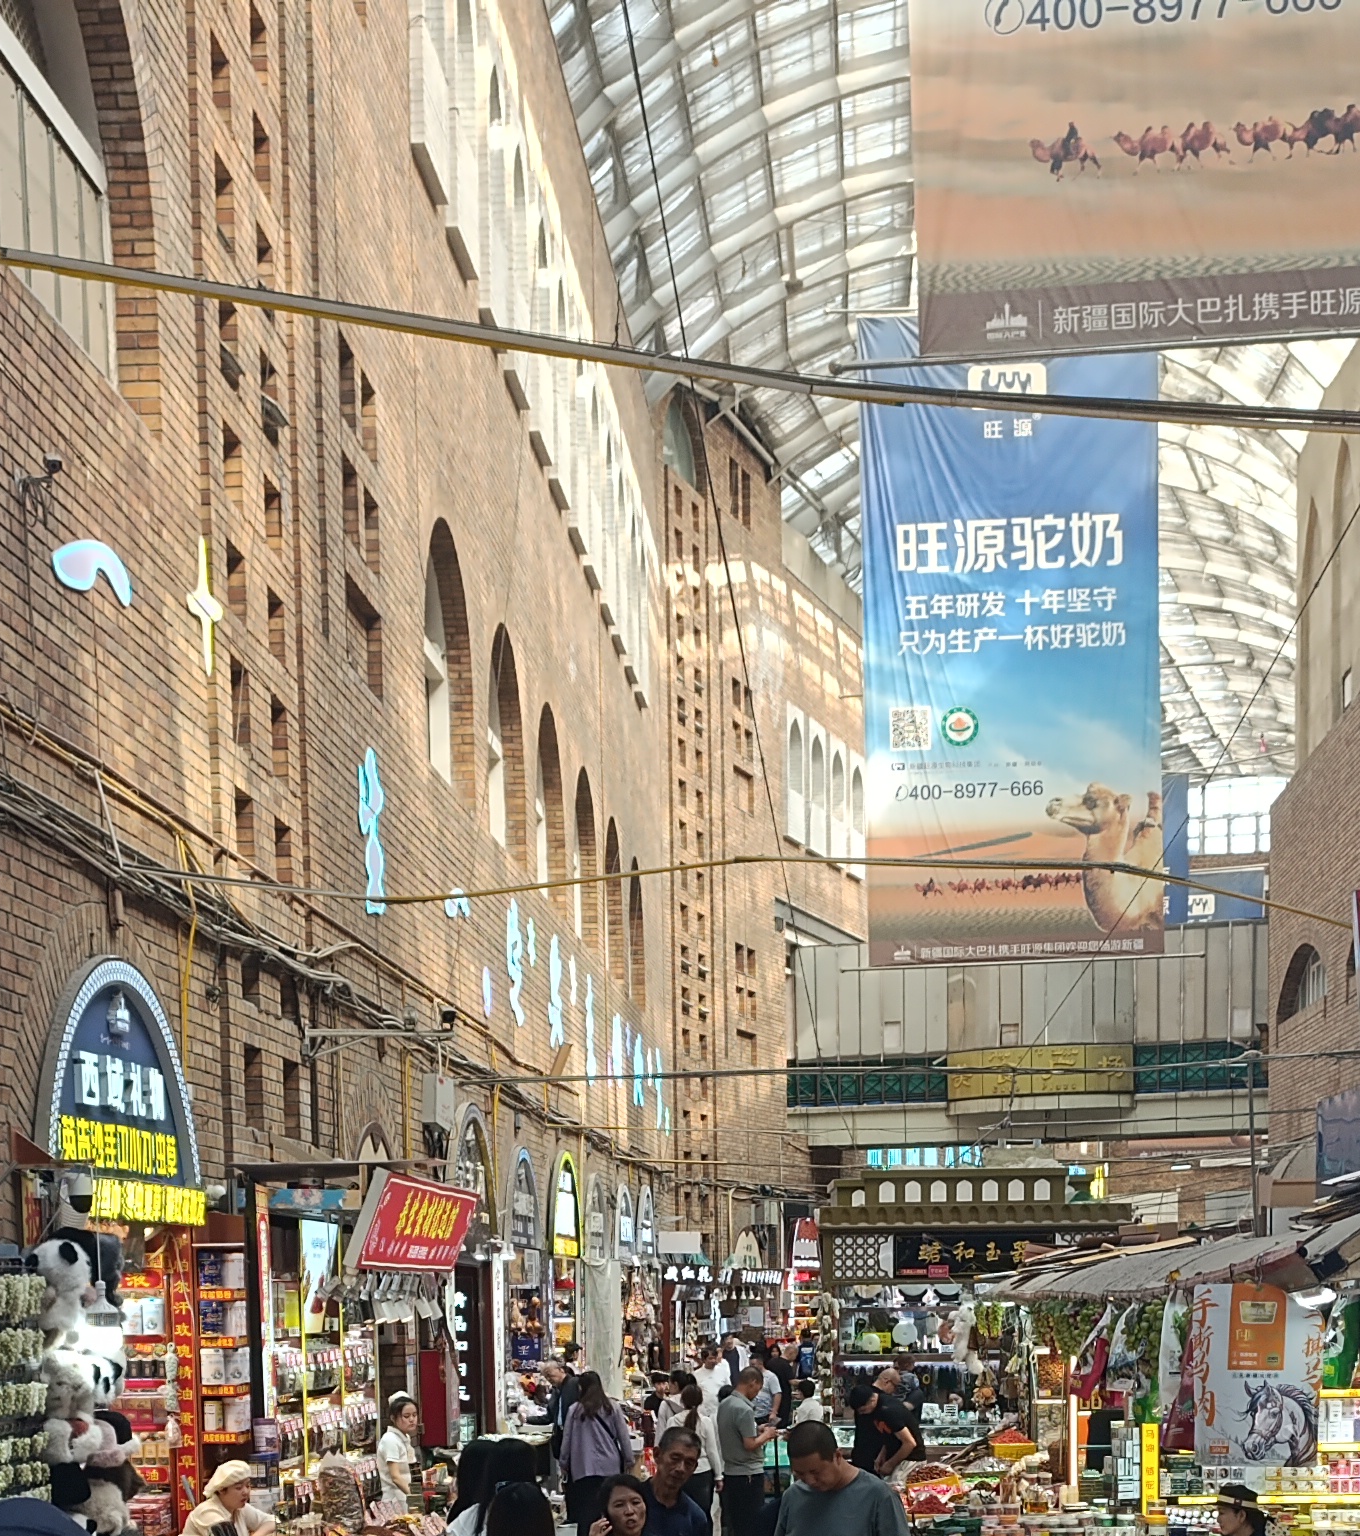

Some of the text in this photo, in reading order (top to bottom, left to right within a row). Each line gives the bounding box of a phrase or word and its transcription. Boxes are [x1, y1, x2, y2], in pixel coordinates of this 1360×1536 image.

[896, 513, 1123, 575] 旺源驼奶
[905, 585, 1118, 621] 五年研发 十年坚守
[898, 622, 1127, 656] 只为生产一杯好驼奶
[909, 780, 1044, 801] 400-8977-666
